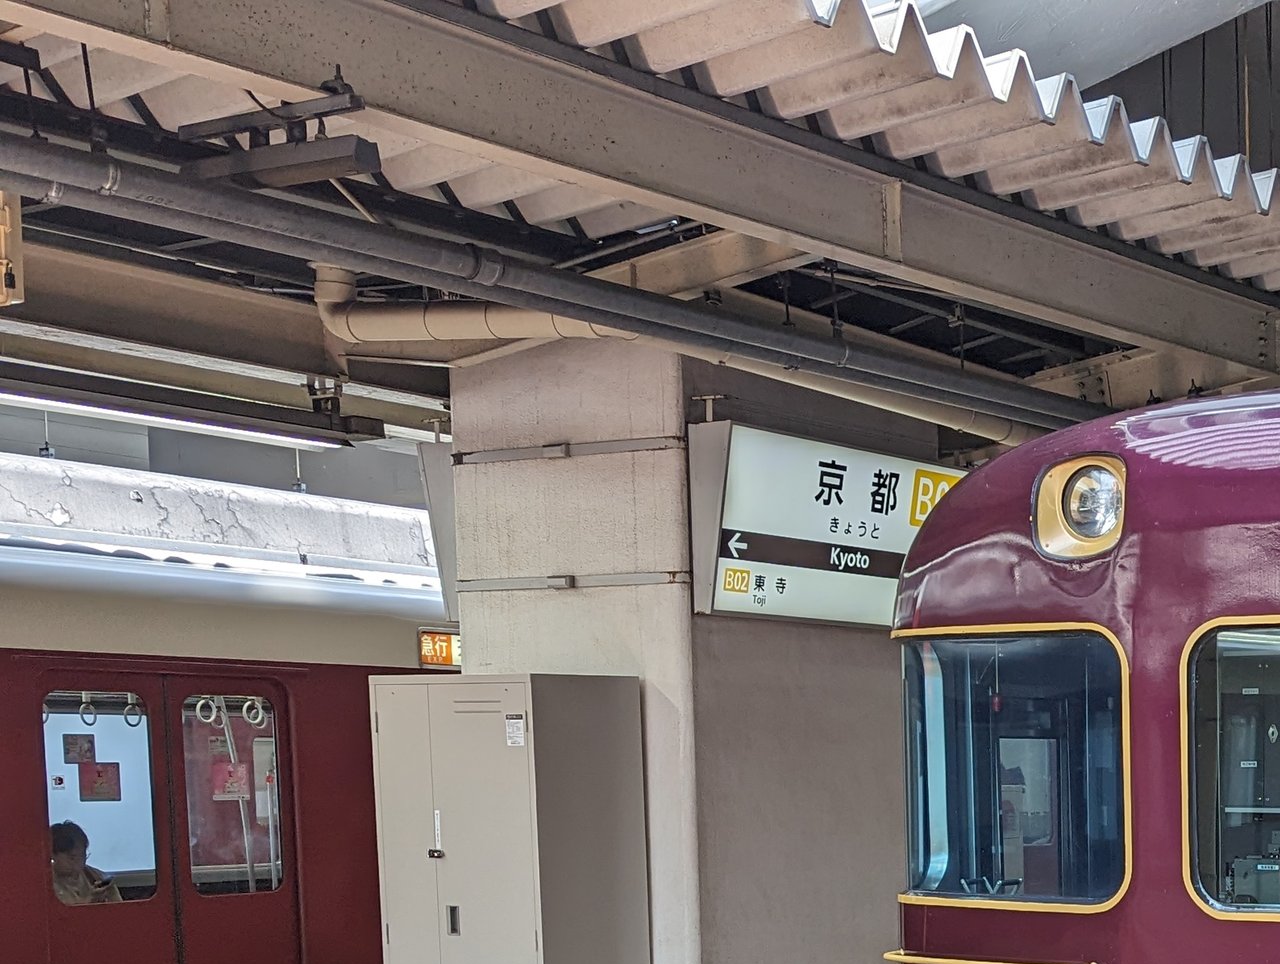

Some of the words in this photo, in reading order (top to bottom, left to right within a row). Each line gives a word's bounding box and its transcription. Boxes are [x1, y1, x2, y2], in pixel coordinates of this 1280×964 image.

[815, 460, 899, 515] 京都
[830, 517, 880, 539] きょうと
[830, 547, 870, 570] Kyoto
[726, 570, 748, 591] B02
[754, 575, 786, 594] 東寺
[753, 595, 766, 606] Toji
[421, 635, 448, 656] 急行
